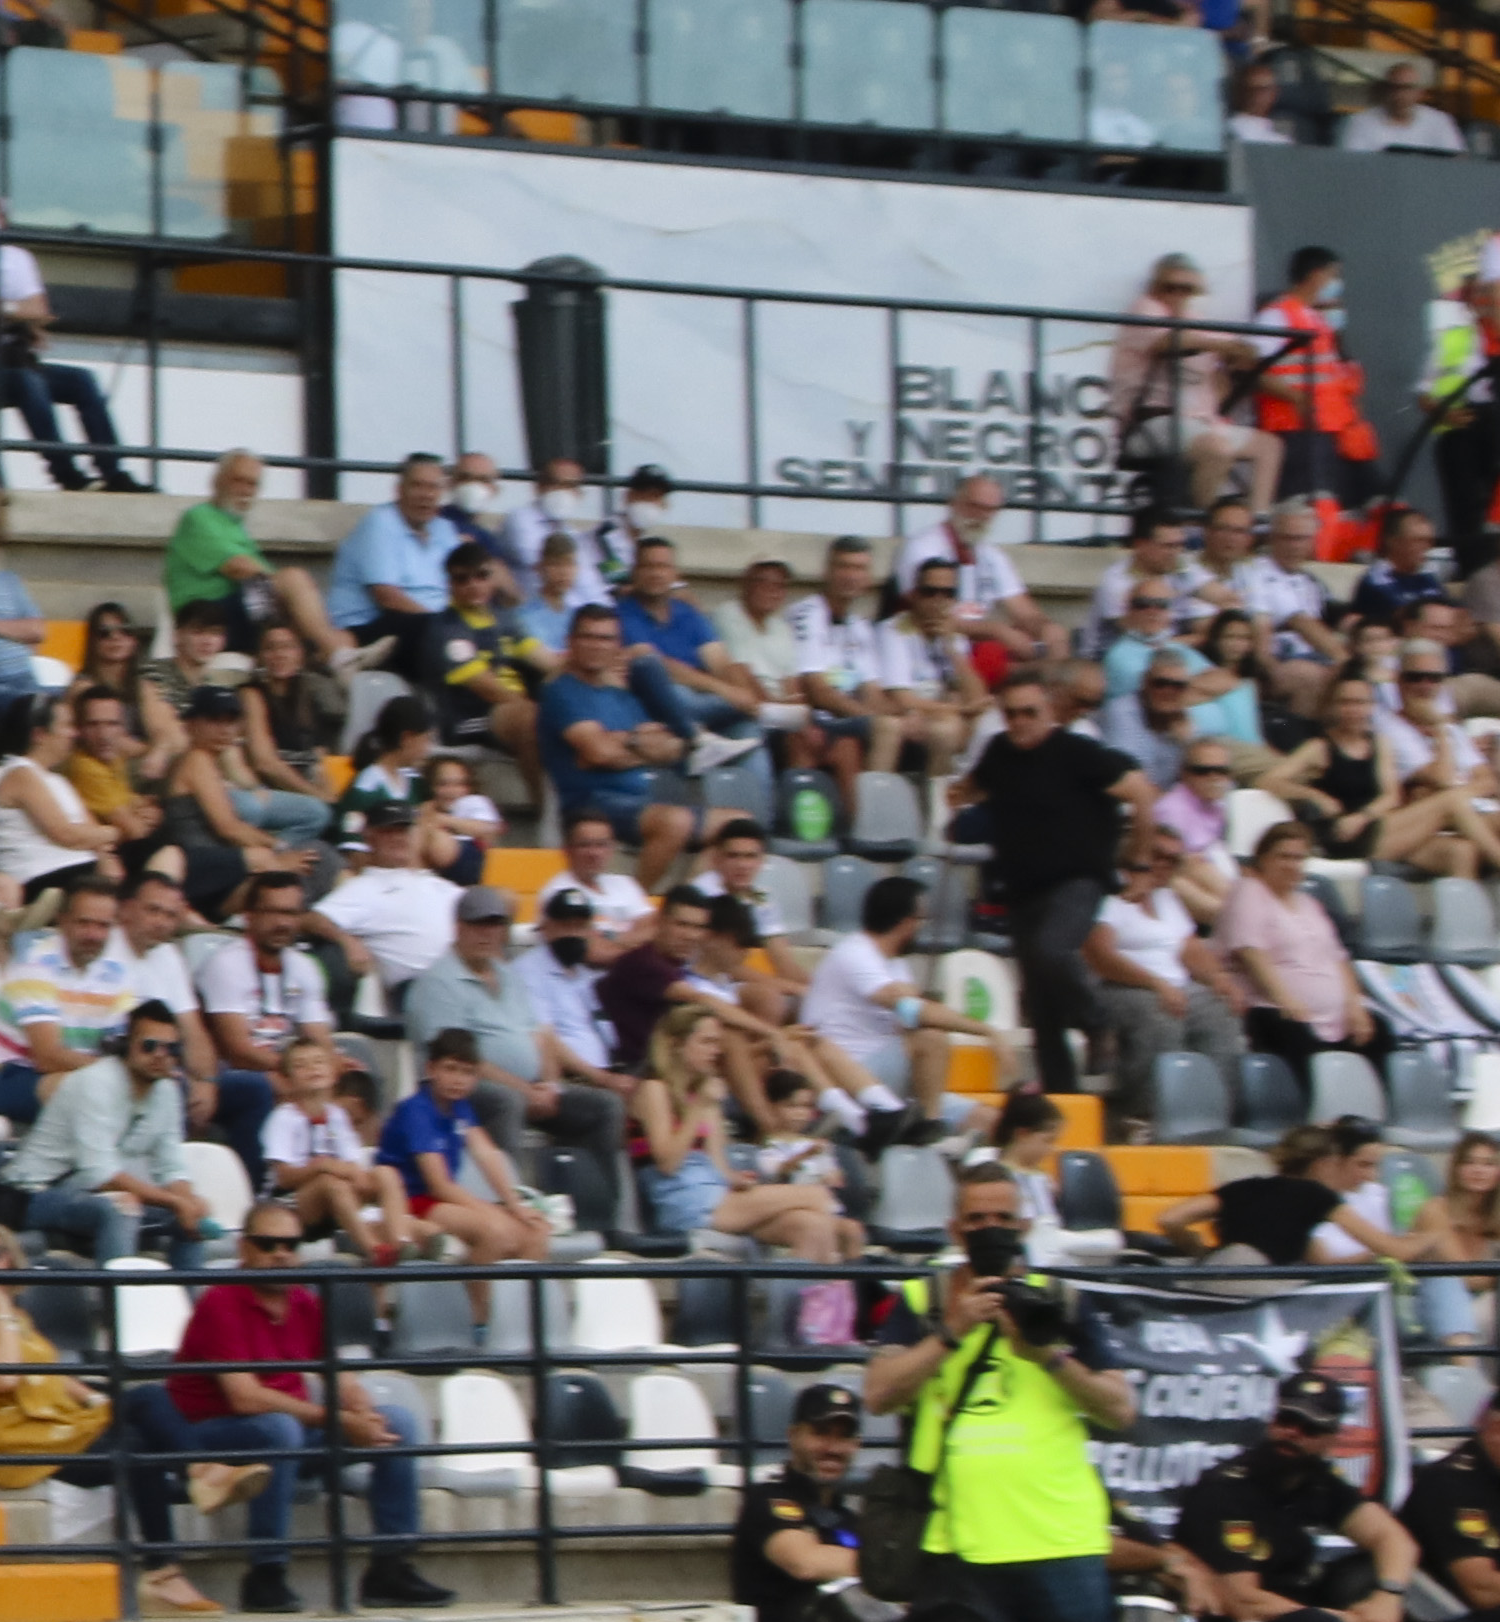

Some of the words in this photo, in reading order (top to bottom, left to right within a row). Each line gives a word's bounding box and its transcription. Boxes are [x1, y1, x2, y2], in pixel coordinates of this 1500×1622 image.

[898, 364, 1110, 418] BLANC
[844, 420, 876, 457] Y
[897, 418, 1112, 470] NEGRO
